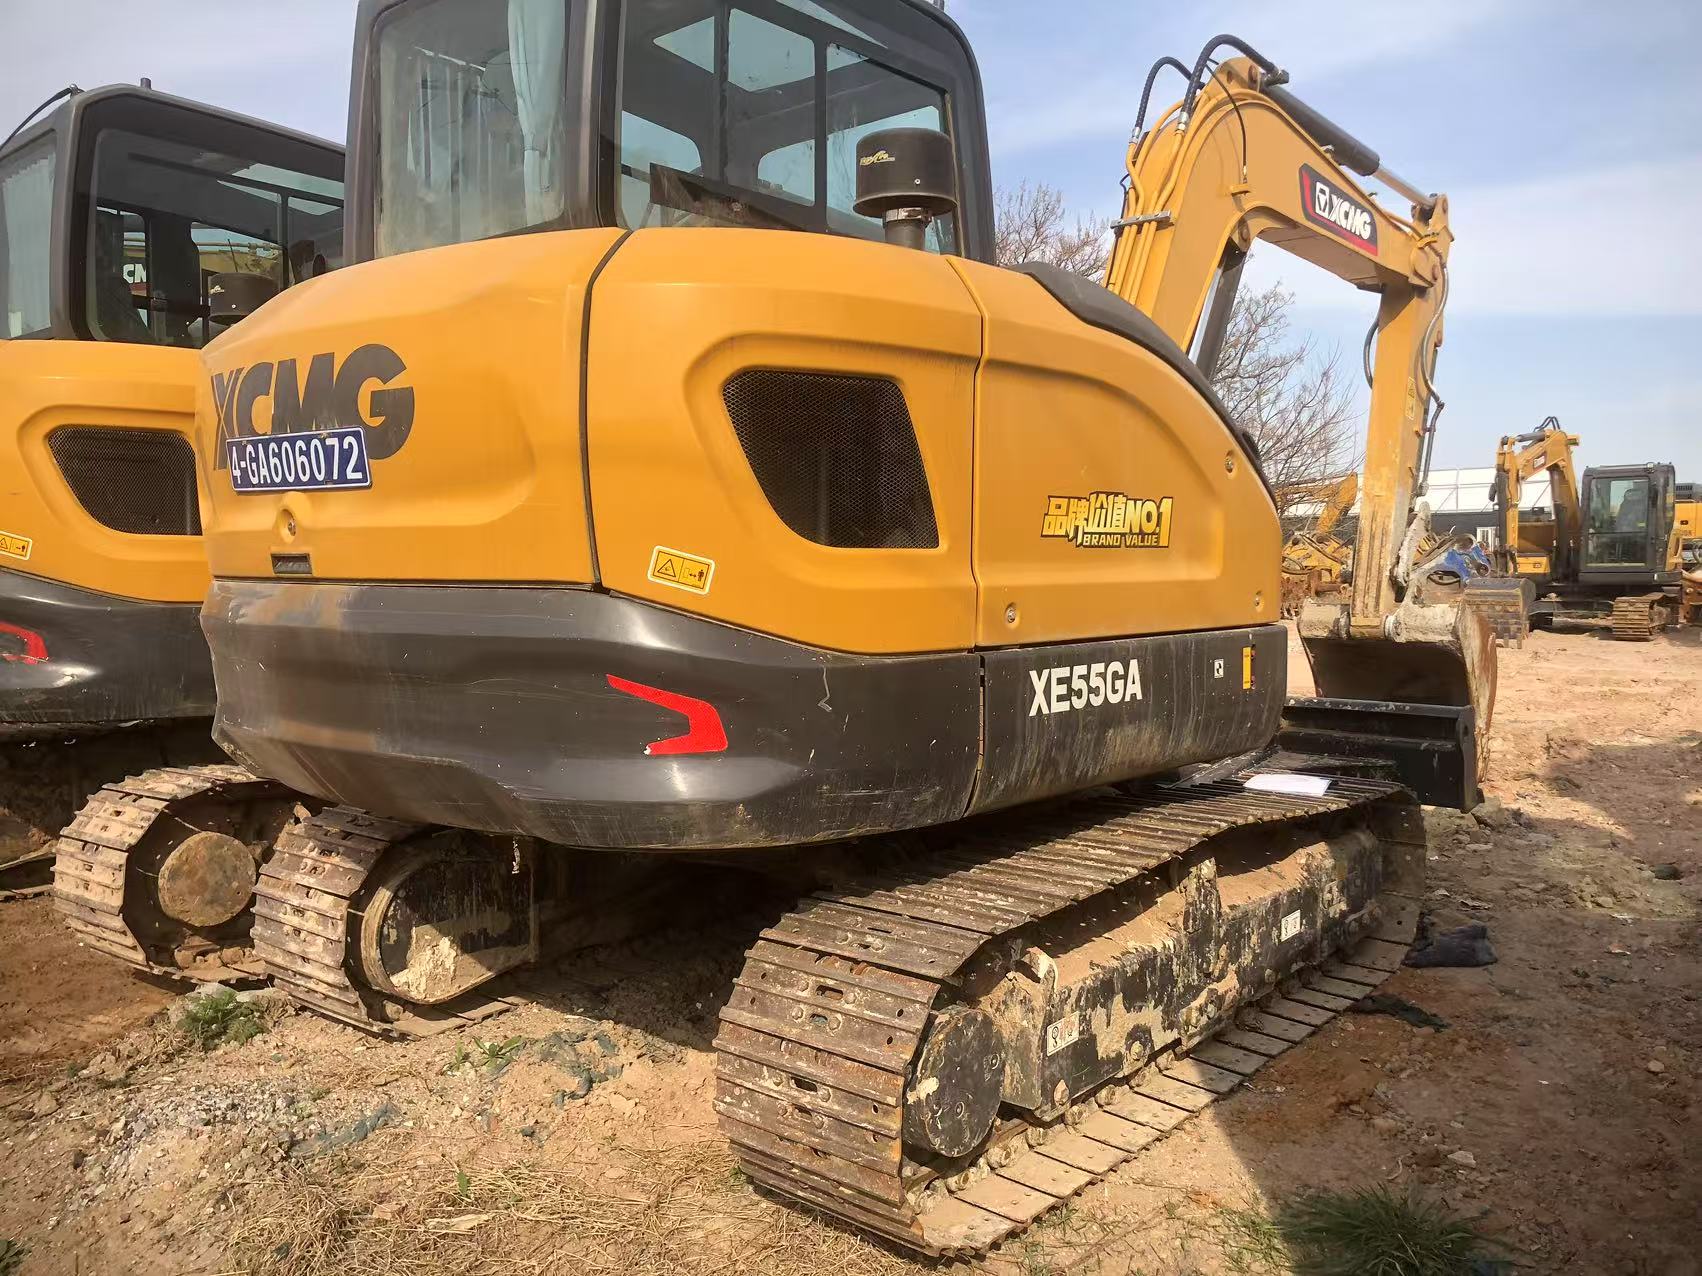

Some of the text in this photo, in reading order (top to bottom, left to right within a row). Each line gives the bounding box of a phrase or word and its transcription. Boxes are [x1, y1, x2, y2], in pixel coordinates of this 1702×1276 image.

[1328, 194, 1371, 239] XCMG
[232, 435, 363, 485] 4-GA606072
[1083, 534, 1159, 546] BRAND VALUE
[1029, 658, 1143, 717] XE55GA
